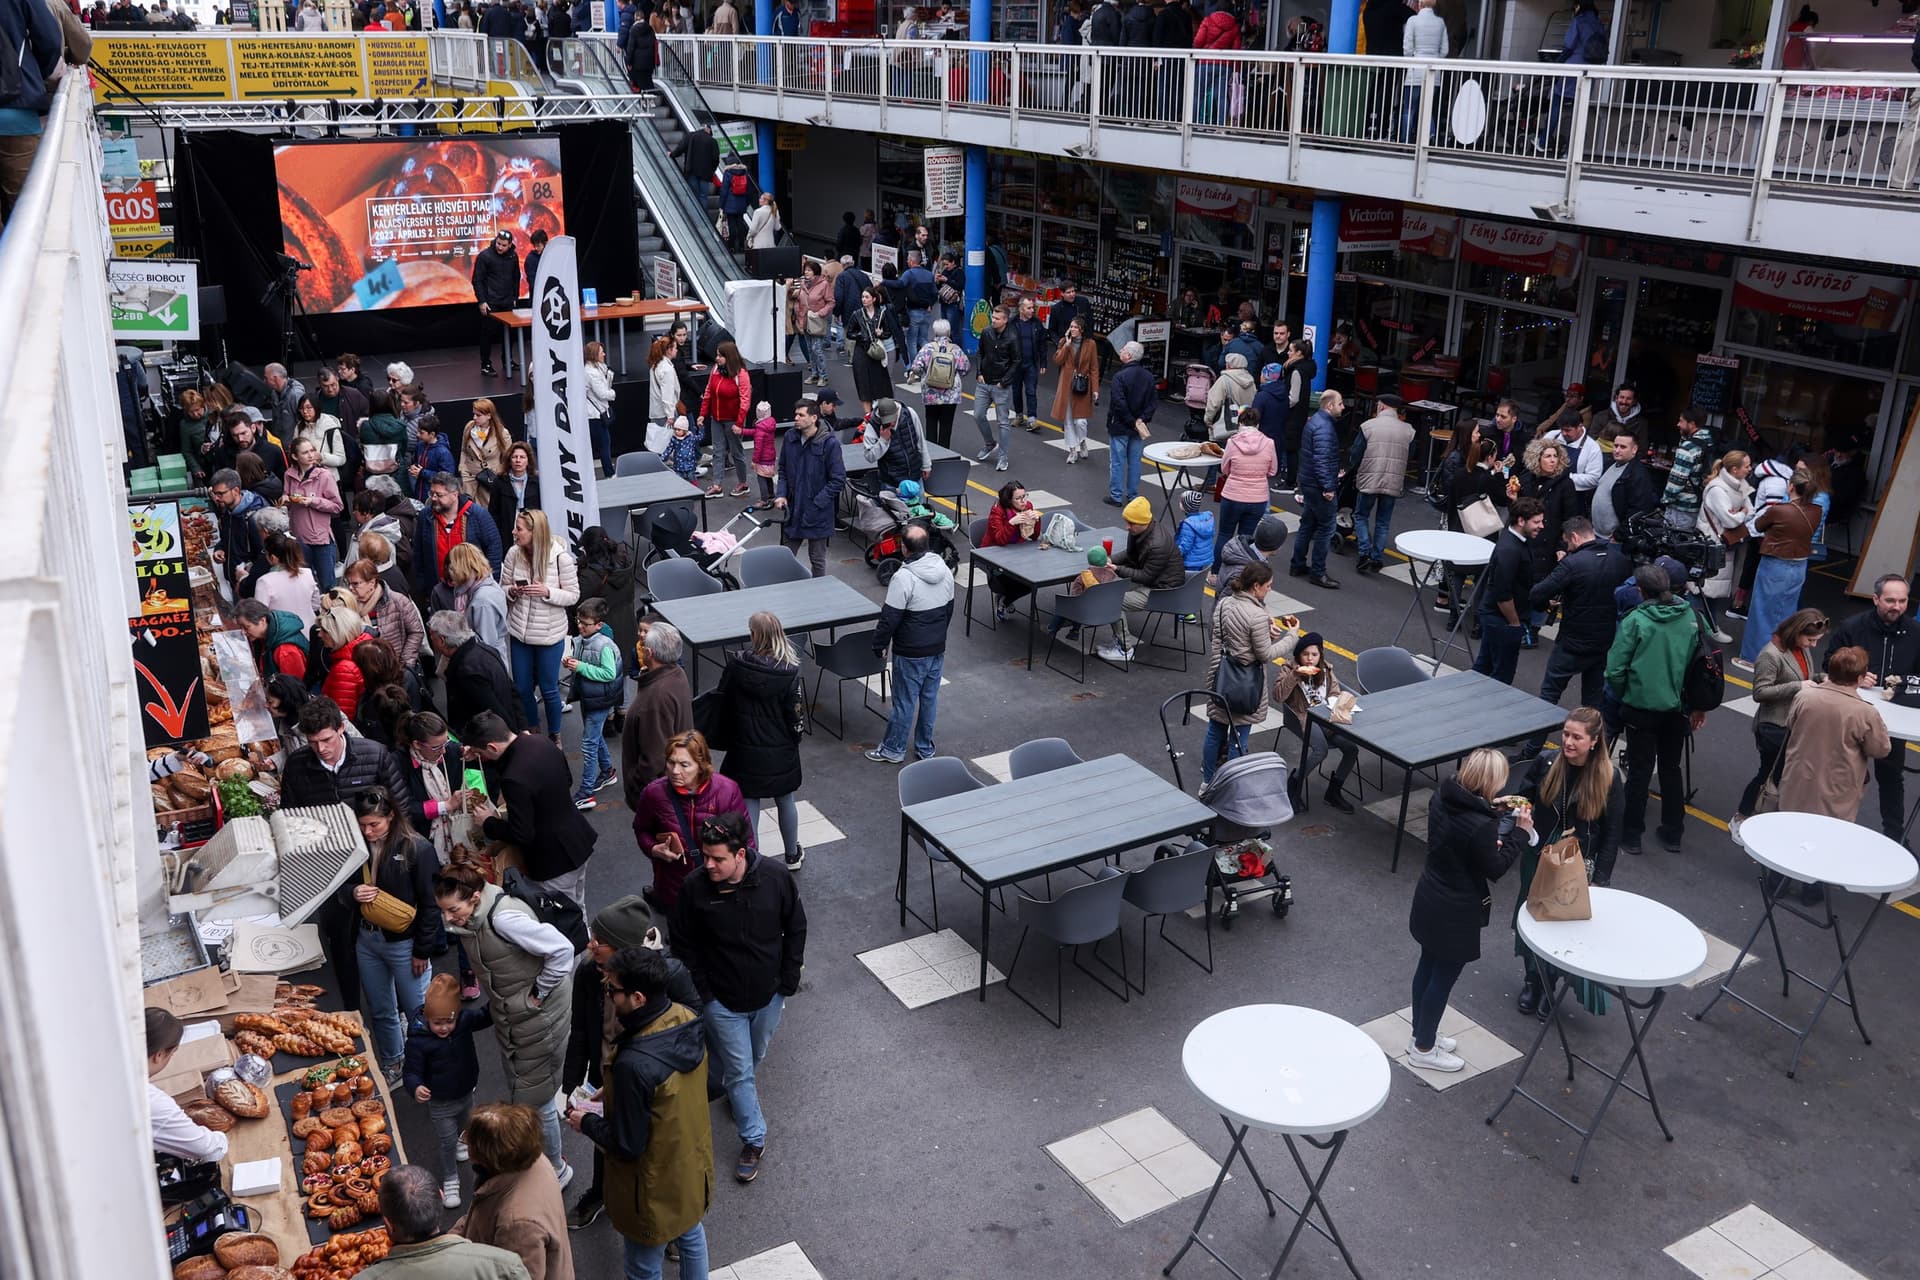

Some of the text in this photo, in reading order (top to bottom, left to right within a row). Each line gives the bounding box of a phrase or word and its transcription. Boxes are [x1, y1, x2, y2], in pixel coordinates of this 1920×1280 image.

[372, 199, 490, 217] KENYÉRLELKE HÚSVÉTI PIAC
[1349, 208, 1394, 222] Victofon
[373, 213, 491, 229] KALÁCSVERSENY ÉS CSALÁDI NAP
[375, 225, 491, 241] 2023. ÁPRILIS 2. FÉNY UTCAI PIAC
[1470, 222, 1498, 244] Fény
[120, 244, 153, 252] PIAC
[147, 274, 186, 283] BIOBOLT
[1748, 263, 1859, 292] Fény Söröző
[549, 348, 571, 434] DAY
[558, 440, 584, 503] MY
